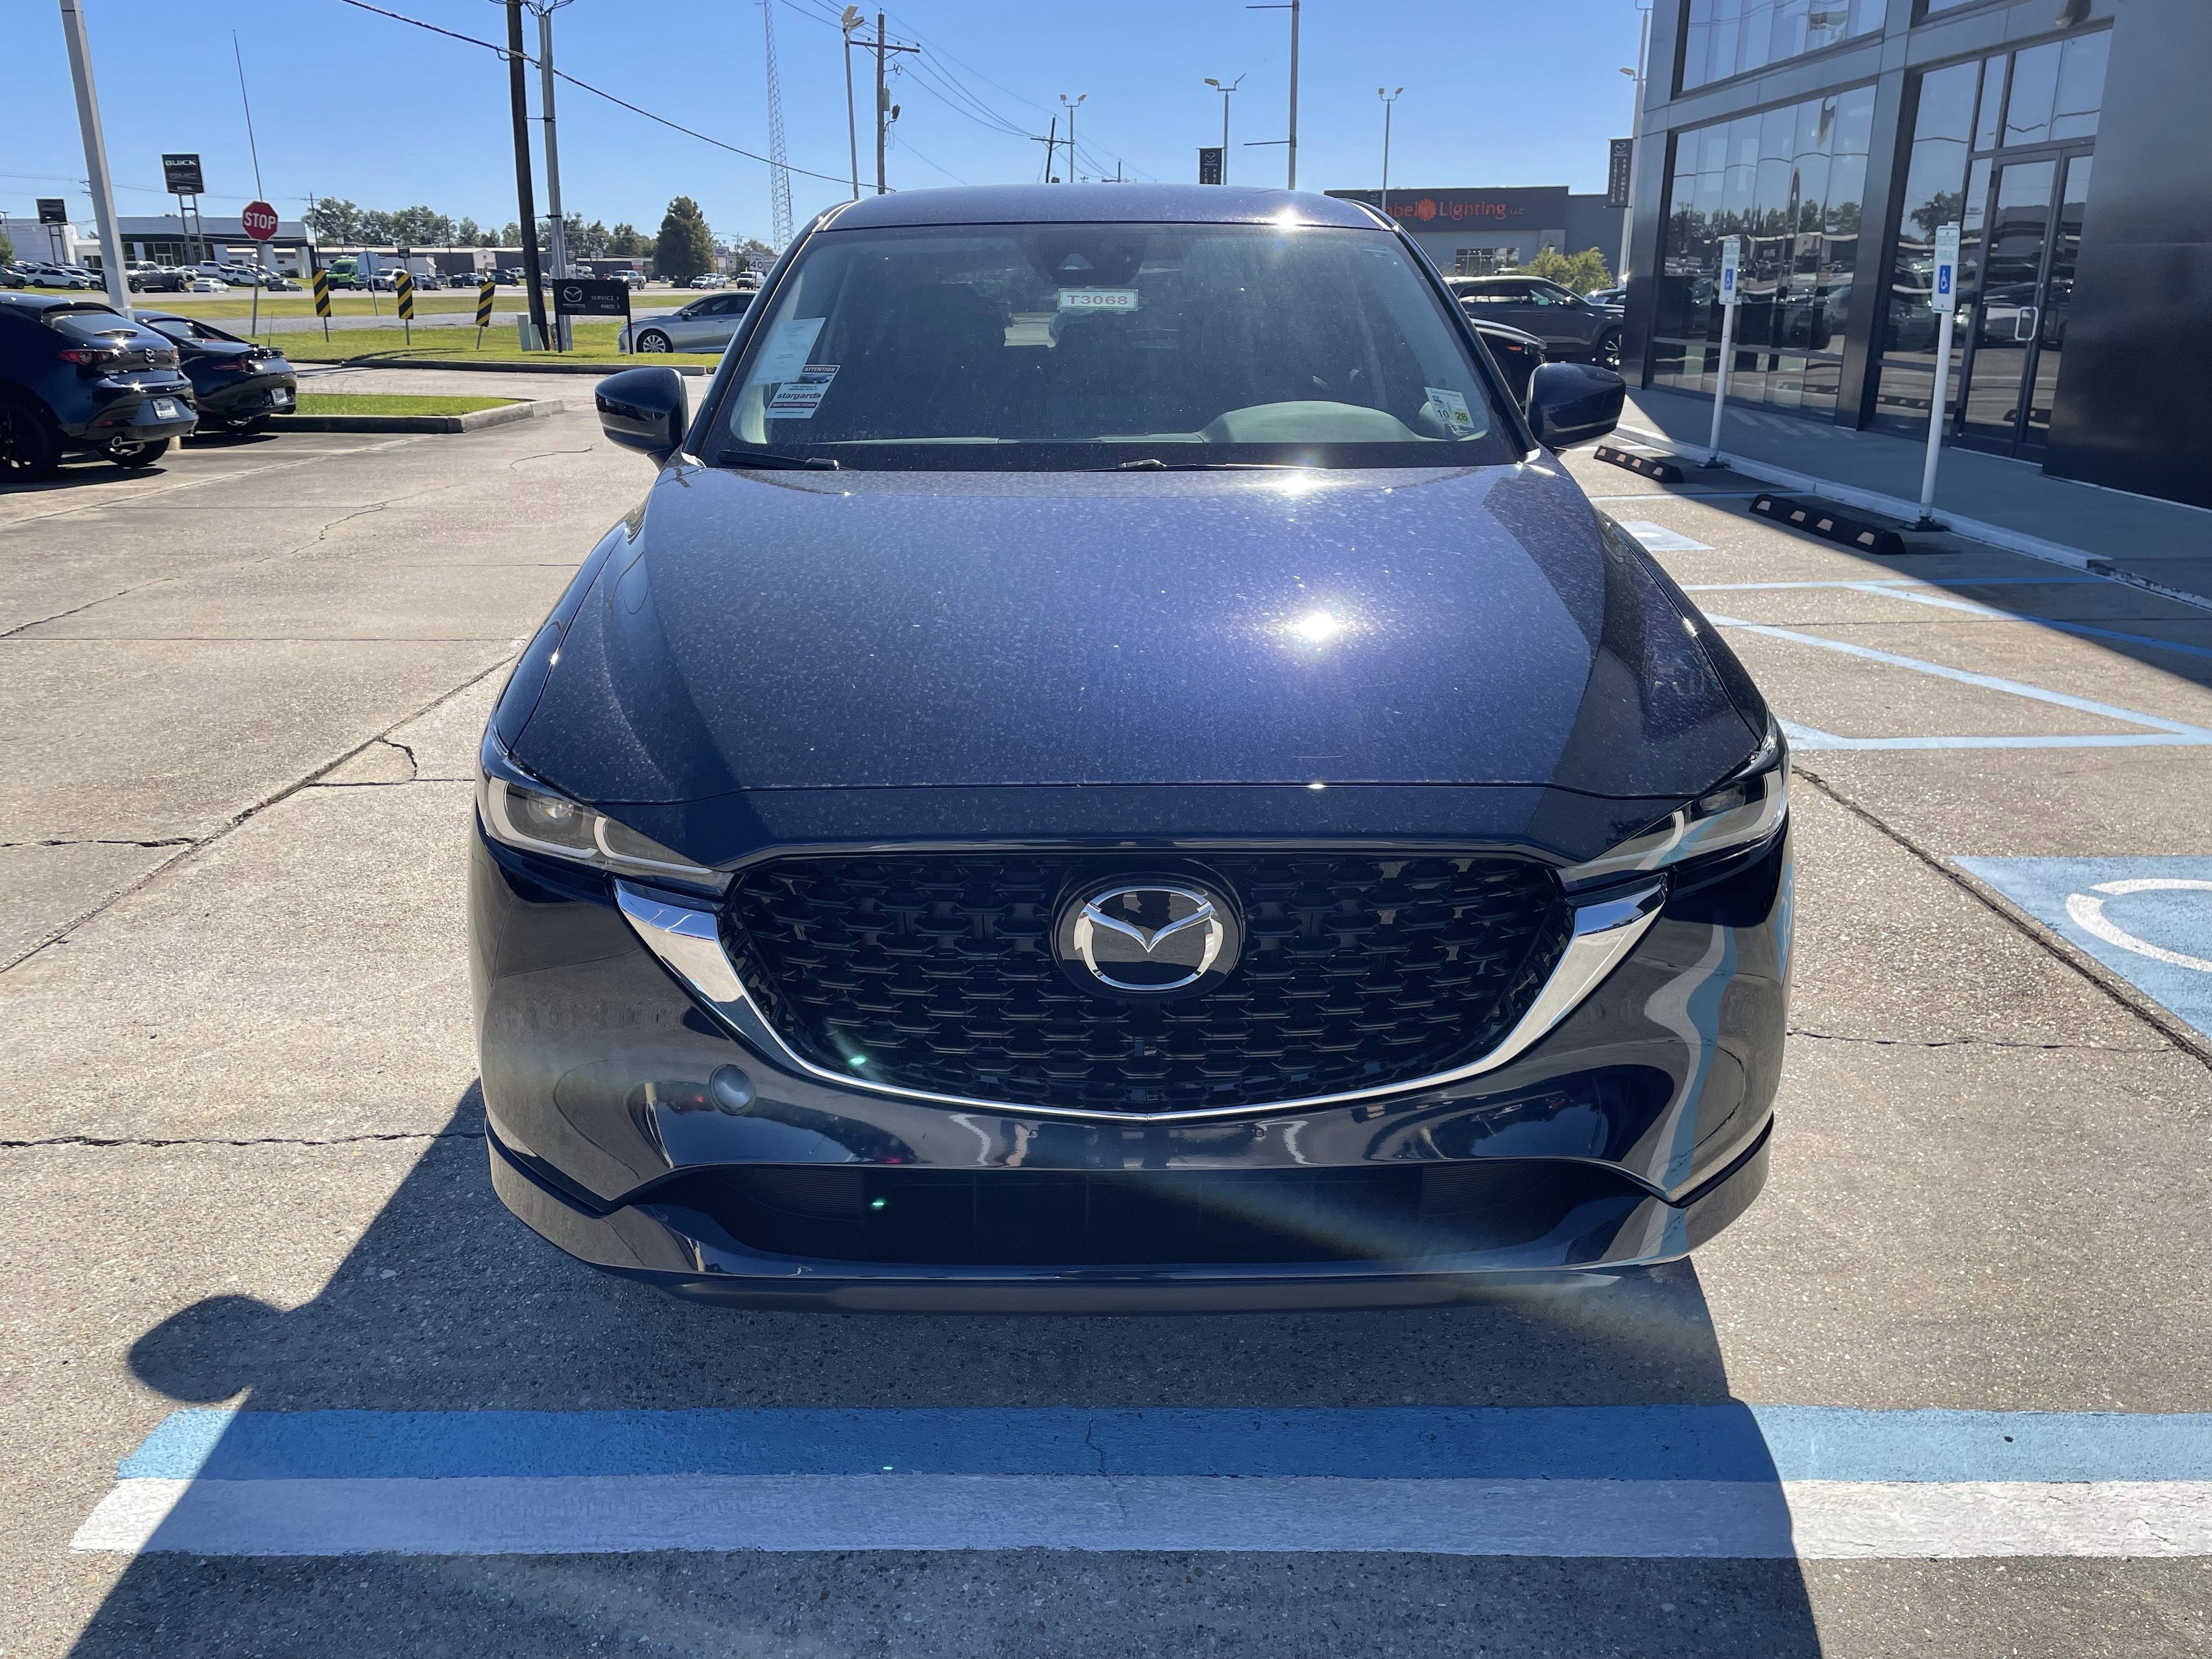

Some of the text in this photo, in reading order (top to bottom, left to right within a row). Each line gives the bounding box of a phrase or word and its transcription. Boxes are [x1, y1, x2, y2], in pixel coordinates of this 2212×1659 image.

[1440, 201, 1508, 220] Lighting
[244, 212, 276, 230] STOP
[751, 261, 763, 269] 40
[1066, 295, 1128, 304] T3068
[1437, 410, 1468, 421] 10 26
